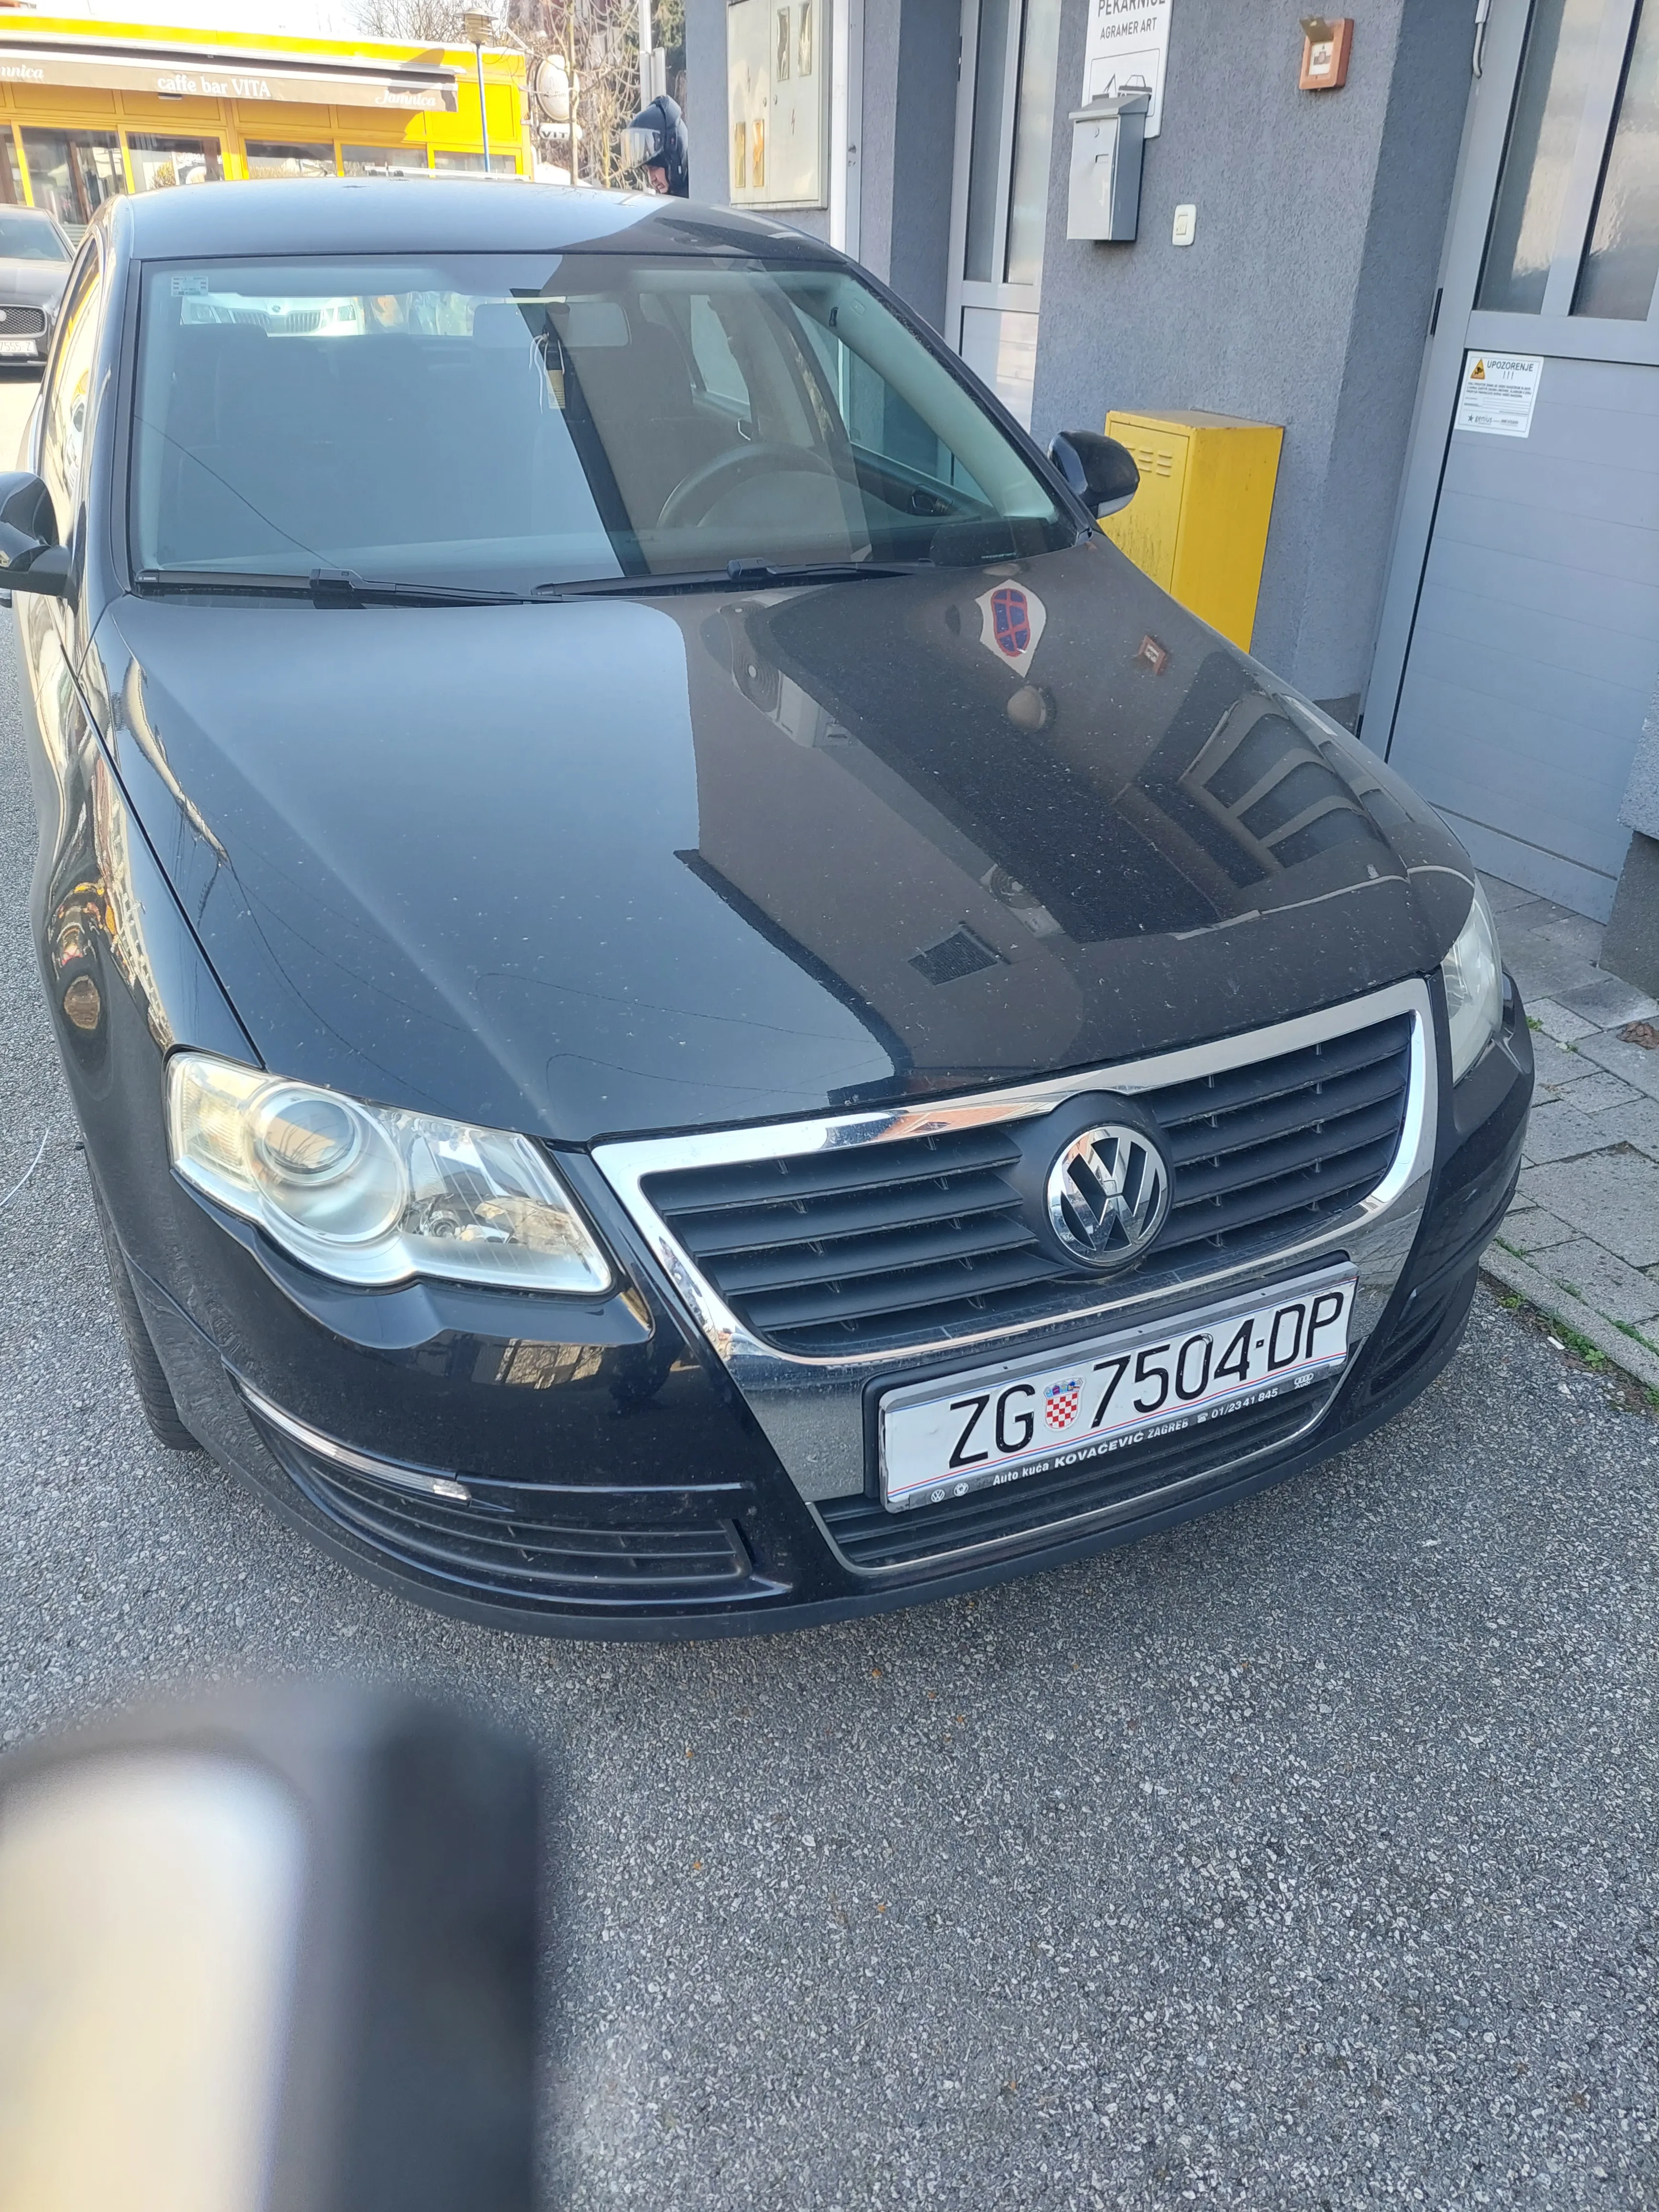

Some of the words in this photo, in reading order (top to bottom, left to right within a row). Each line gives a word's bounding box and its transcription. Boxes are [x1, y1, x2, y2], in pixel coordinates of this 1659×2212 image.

[1098, 0, 1166, 17] PEKARN
[1100, 21, 1139, 40] AGRAMER
[1140, 17, 1157, 33] ART
[157, 74, 197, 92] caffe
[200, 75, 228, 95] bar
[231, 78, 272, 98] VITA
[374, 89, 436, 106] Jamnica
[542, 131, 568, 139] VIT
[1487, 360, 1534, 372] UPOZORENJE
[949, 1383, 1034, 1469] ZG
[993, 1470, 1018, 1485] Auto
[1147, 1417, 1189, 1439] ZAGREB
[1258, 1387, 1278, 1402] 845
